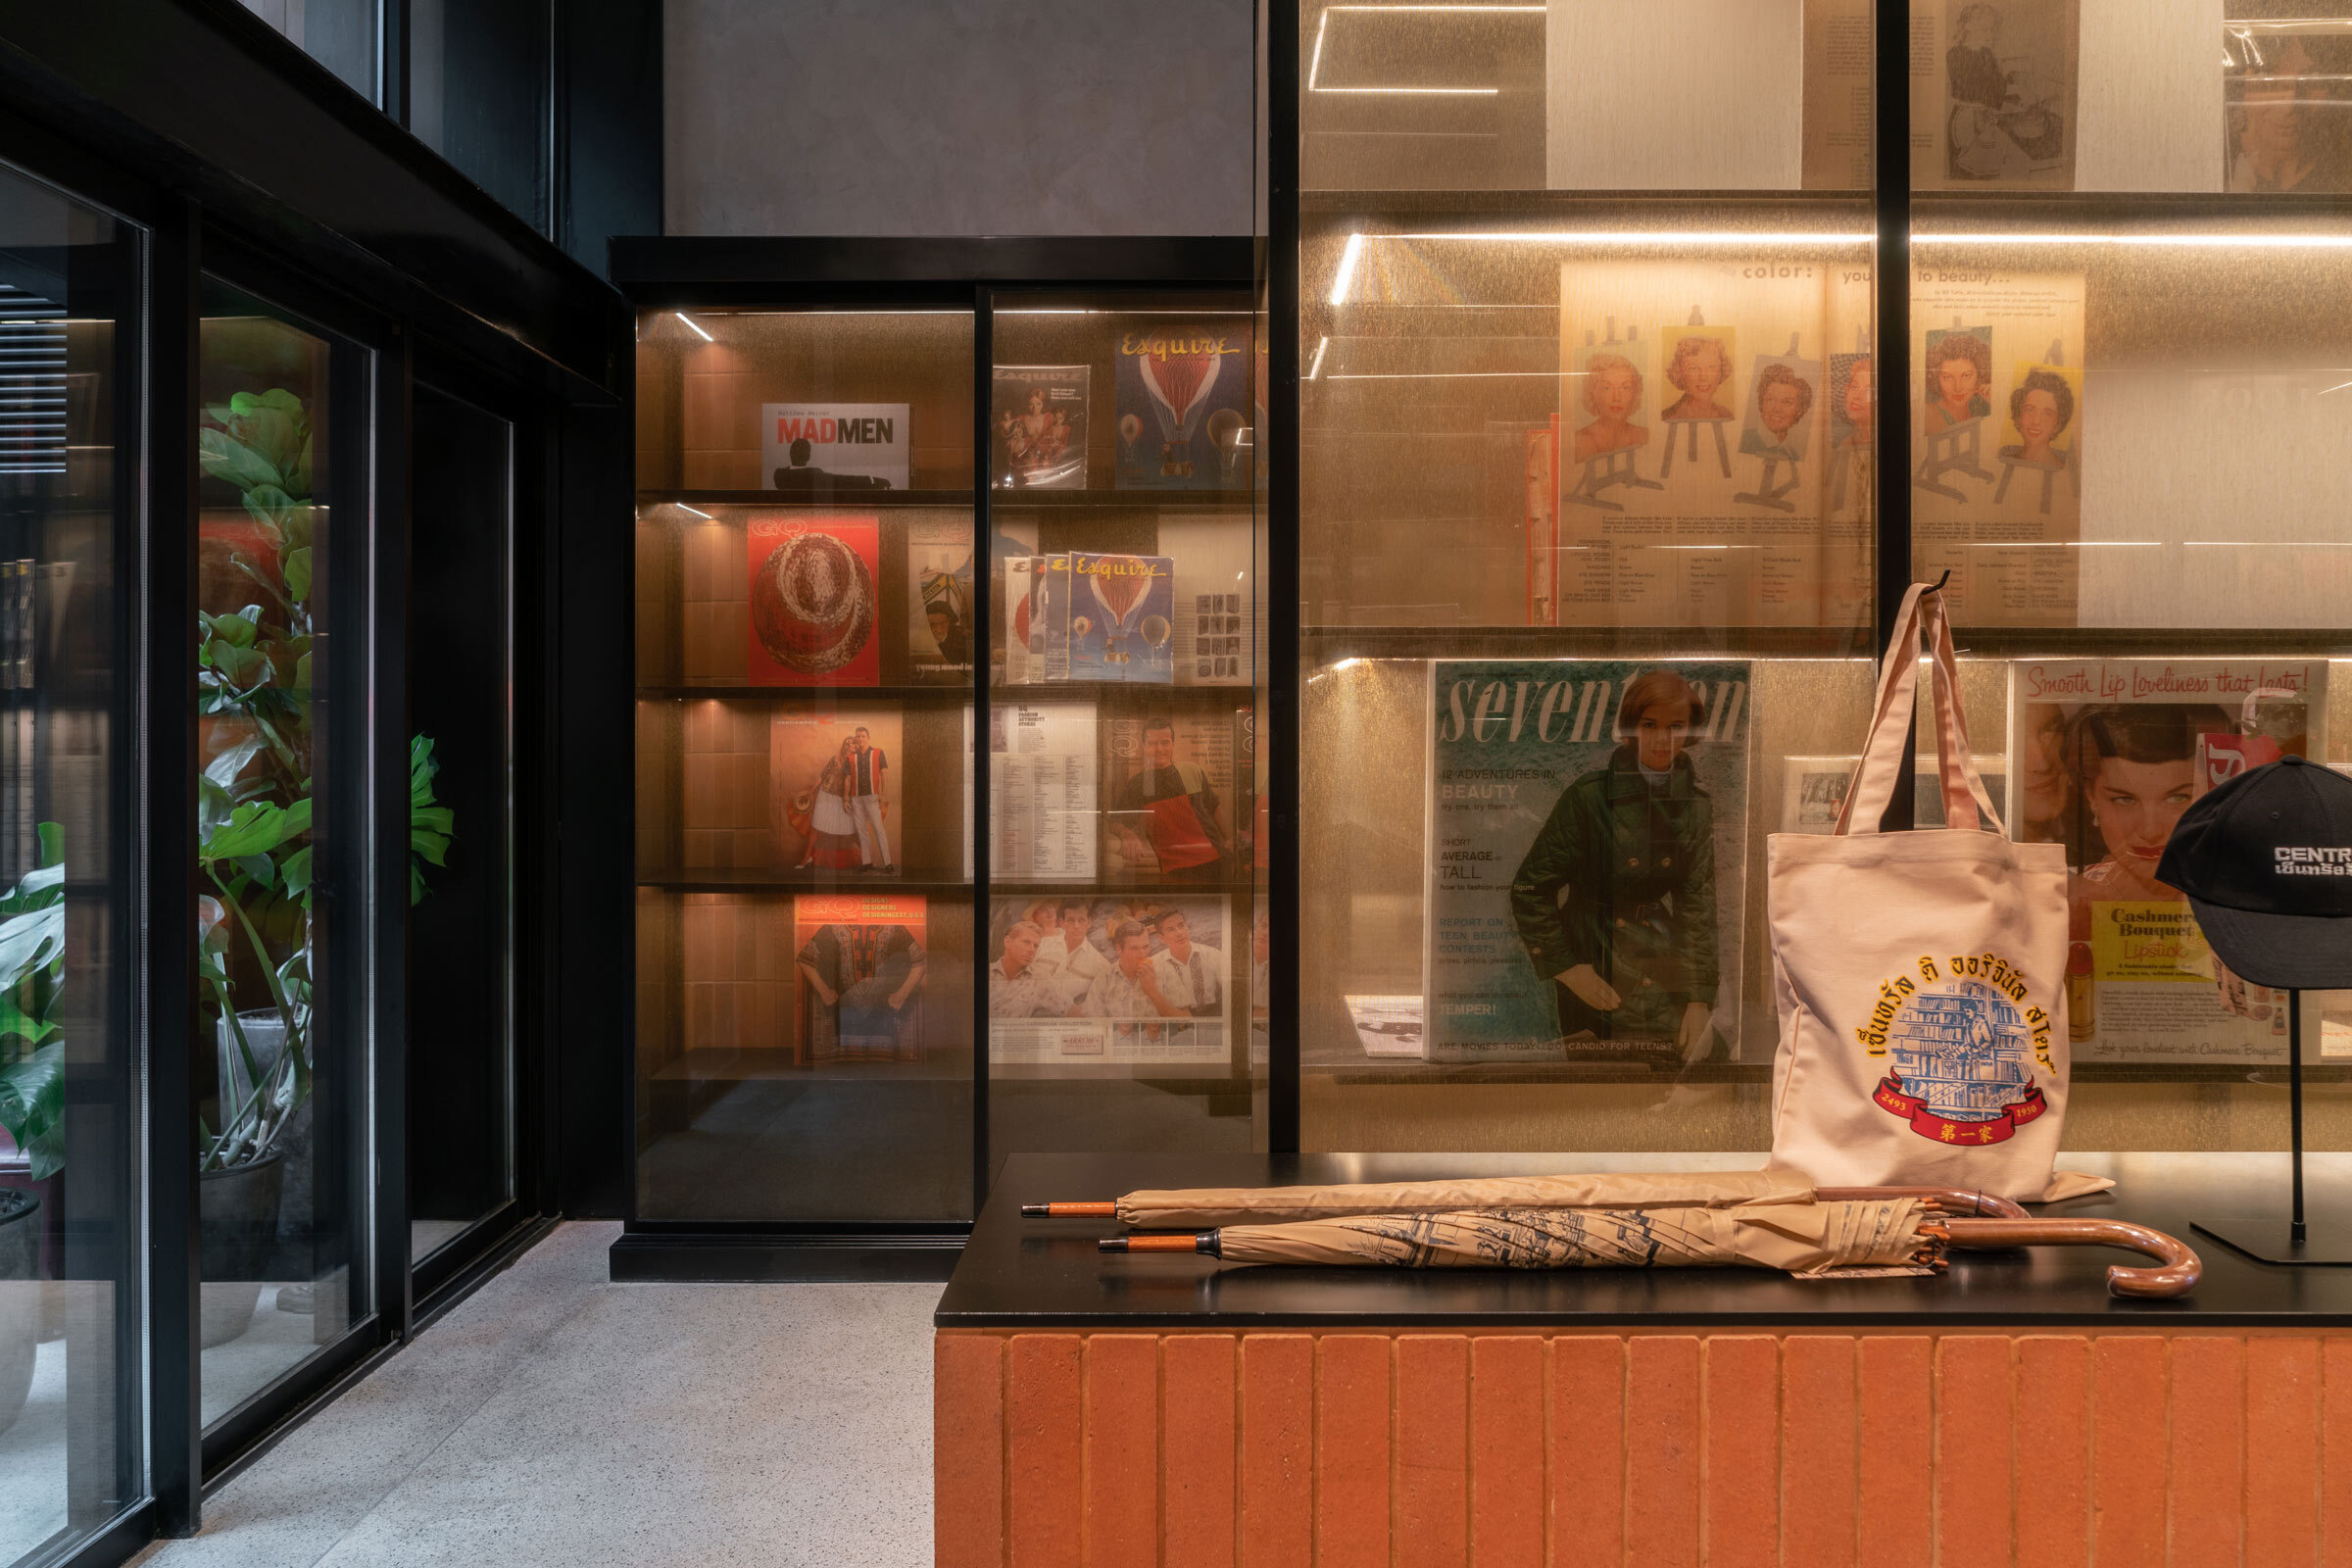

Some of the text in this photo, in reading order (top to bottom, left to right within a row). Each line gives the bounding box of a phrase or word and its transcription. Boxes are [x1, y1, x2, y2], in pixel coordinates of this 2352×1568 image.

[1743, 262, 1811, 278] color:
[1938, 272, 2010, 286] beauty...
[1120, 332, 1242, 364] Esquire
[751, 518, 808, 539] GQ
[1077, 557, 1167, 580] Esquire
[2027, 664, 2095, 697] Smooth
[2100, 663, 2126, 701] Lip
[2132, 665, 2208, 699] Loveliness
[2216, 667, 2255, 694] that
[1457, 769, 1540, 780] ADVENTURES
[1544, 769, 1556, 780] IN
[1442, 784, 1519, 800] BEAUTY
[1442, 838, 1472, 847] SHORT
[1441, 851, 1494, 861] AVERAGE
[2275, 847, 2352, 862] CENTR
[1440, 865, 1483, 879] TALL
[1495, 885, 1512, 894] your
[799, 897, 860, 918] GQ
[1439, 917, 1504, 926] REPORT ON
[1439, 931, 1519, 941] TEEN BEAUTY
[2119, 924, 2194, 940] Bouquet
[1439, 944, 1496, 954] CONTESTS
[2124, 940, 2189, 964] Lipstick
[1440, 1004, 1497, 1015] TEMPER!
[1437, 1042, 1457, 1051] ARE
[1461, 1042, 1499, 1051] MOVIES
[1503, 1042, 1536, 1051] TODAY
[1568, 1041, 1605, 1051] CANDID
[1610, 1042, 1631, 1051] FOR
[1634, 1041, 1673, 1051] TEENS?
[2119, 1043, 2141, 1058] your
[2142, 1040, 2177, 1054] loveliest
[2199, 1041, 2241, 1055] Cashmere
[2241, 1042, 2290, 1059] Bouquet
[1881, 1093, 1907, 1112] 2493
[2015, 1103, 2037, 1117] 1950
[1940, 1123, 1994, 1144] 第一家
